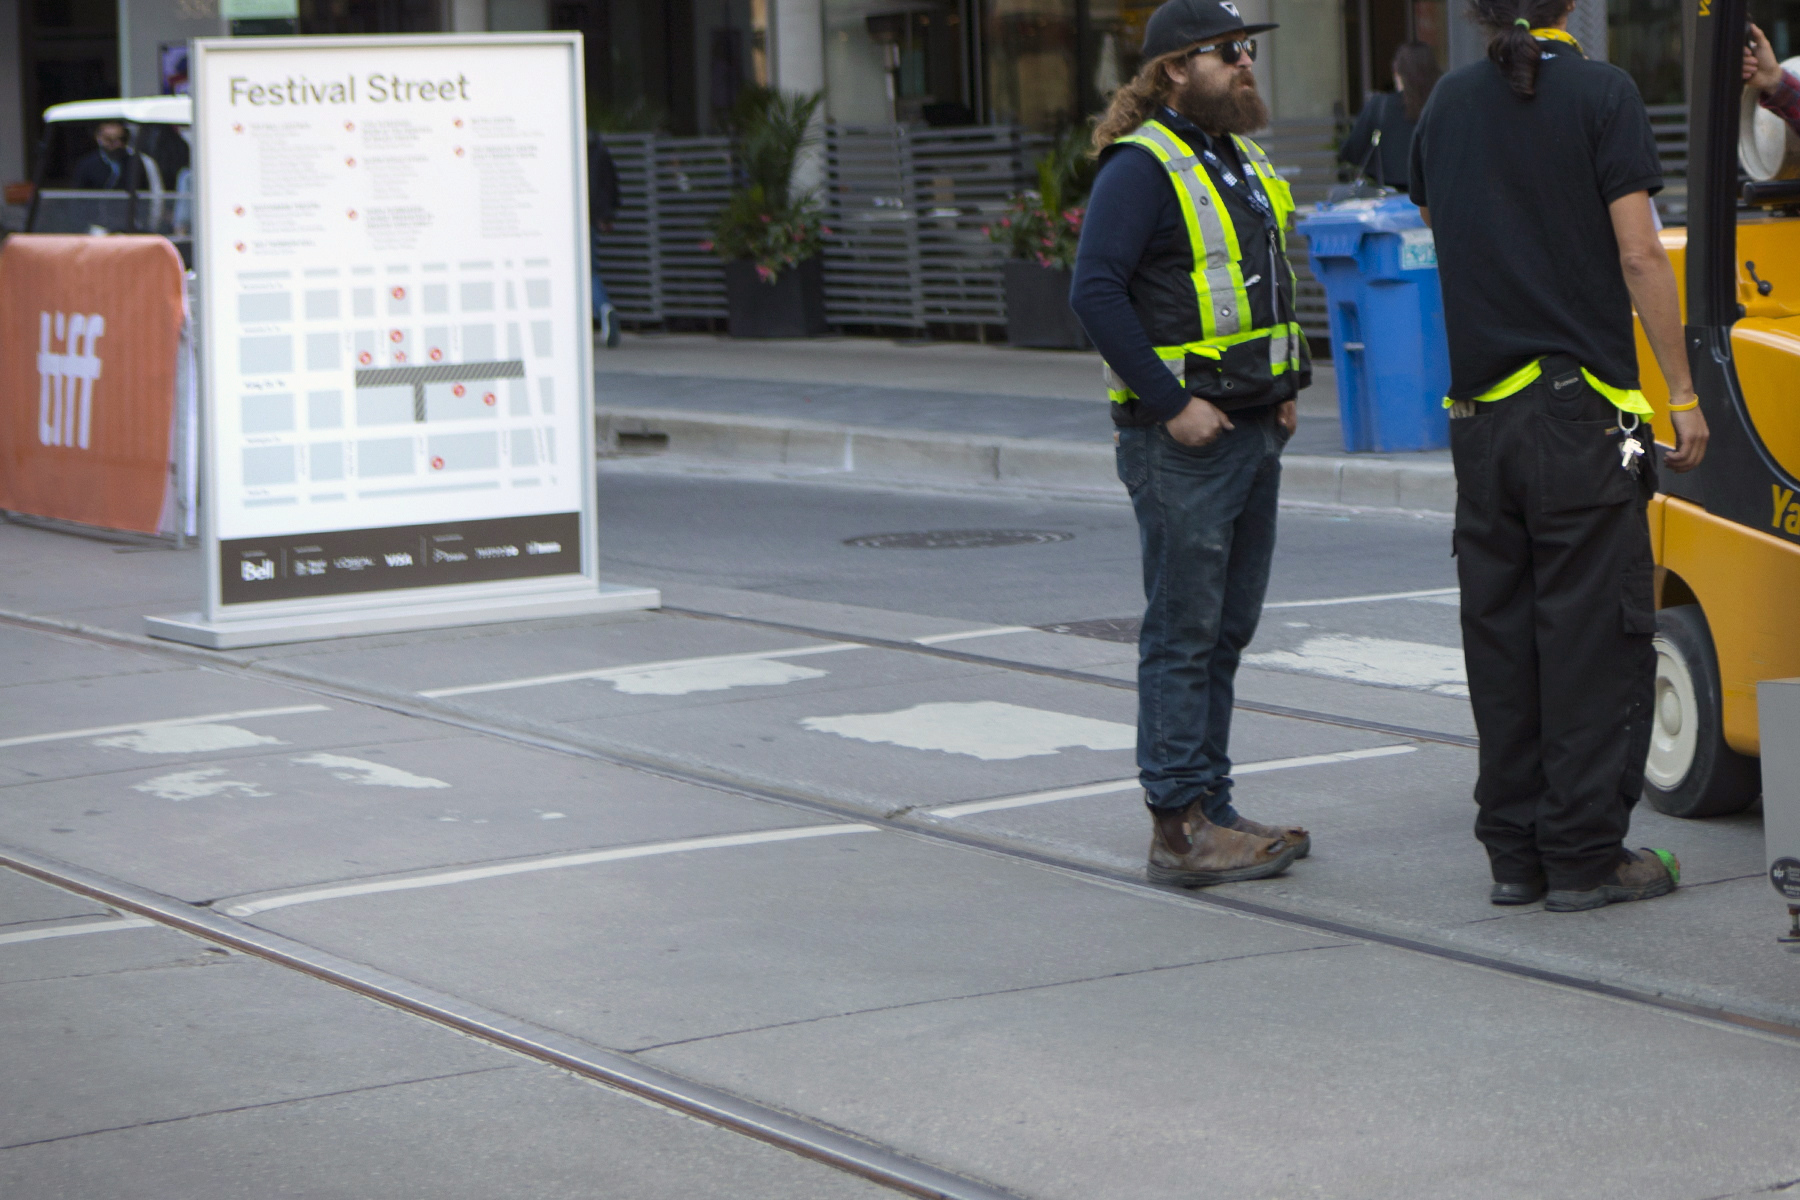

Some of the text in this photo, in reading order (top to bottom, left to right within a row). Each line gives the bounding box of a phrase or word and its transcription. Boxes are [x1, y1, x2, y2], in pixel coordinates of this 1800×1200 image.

[229, 72, 471, 106] Festival Street
[240, 558, 275, 582] Bell
